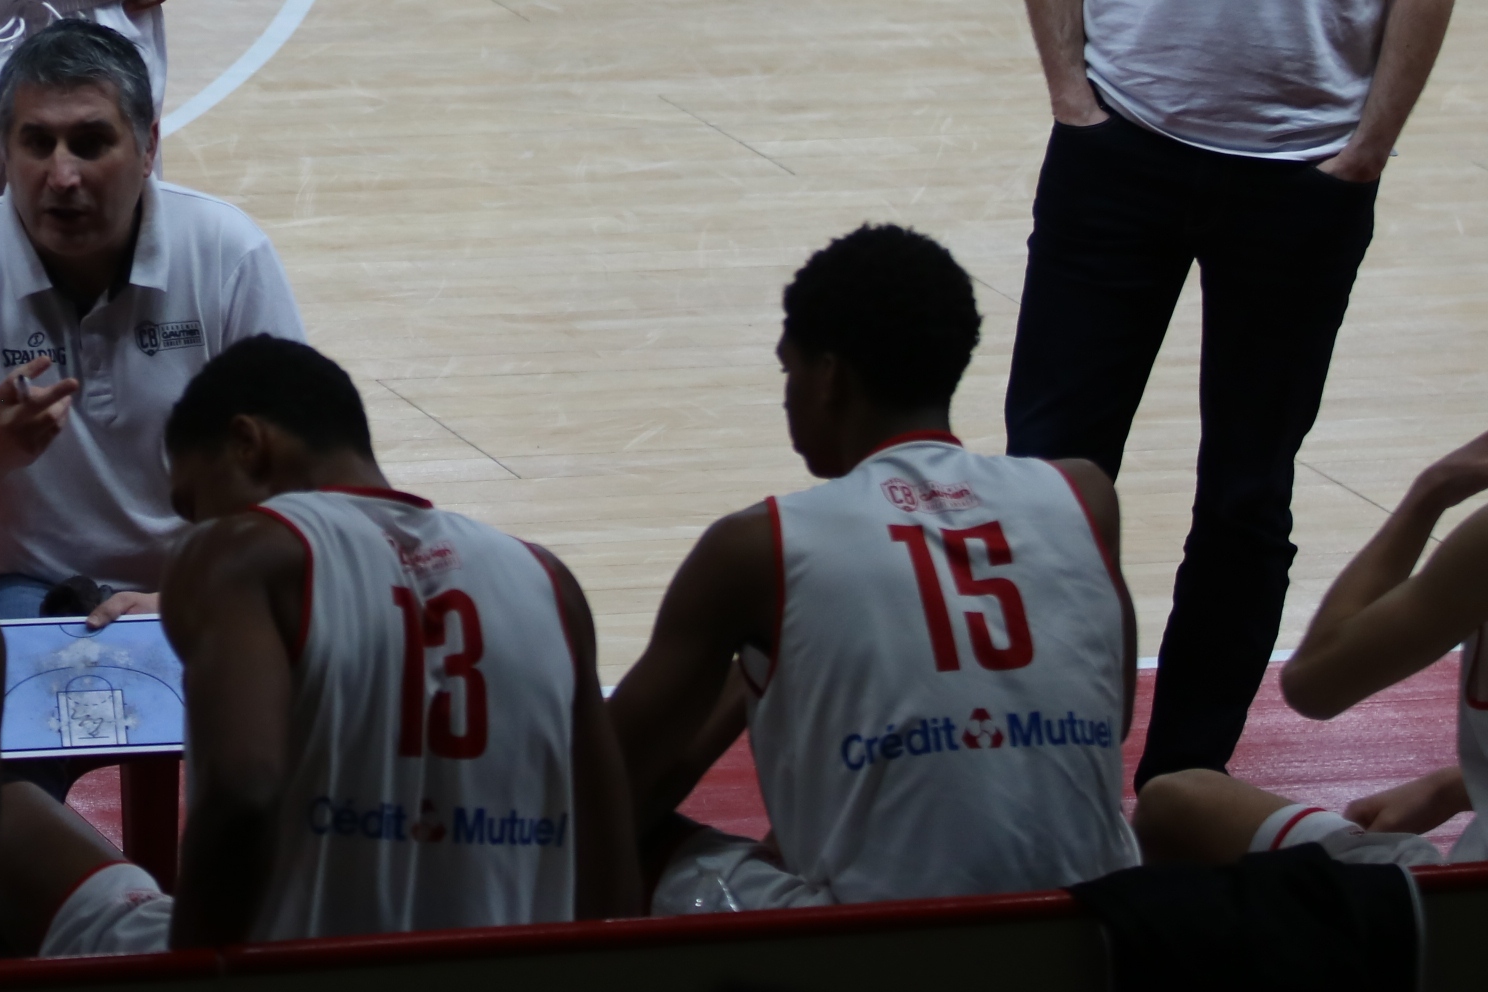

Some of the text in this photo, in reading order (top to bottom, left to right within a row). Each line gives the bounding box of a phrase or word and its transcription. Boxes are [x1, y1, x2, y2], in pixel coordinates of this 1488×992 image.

[139, 328, 158, 348] CB
[888, 485, 916, 505] CB
[887, 521, 1034, 673] 15
[391, 585, 488, 760] 13
[841, 717, 959, 771] Crédit
[453, 806, 568, 847] Mutuel
